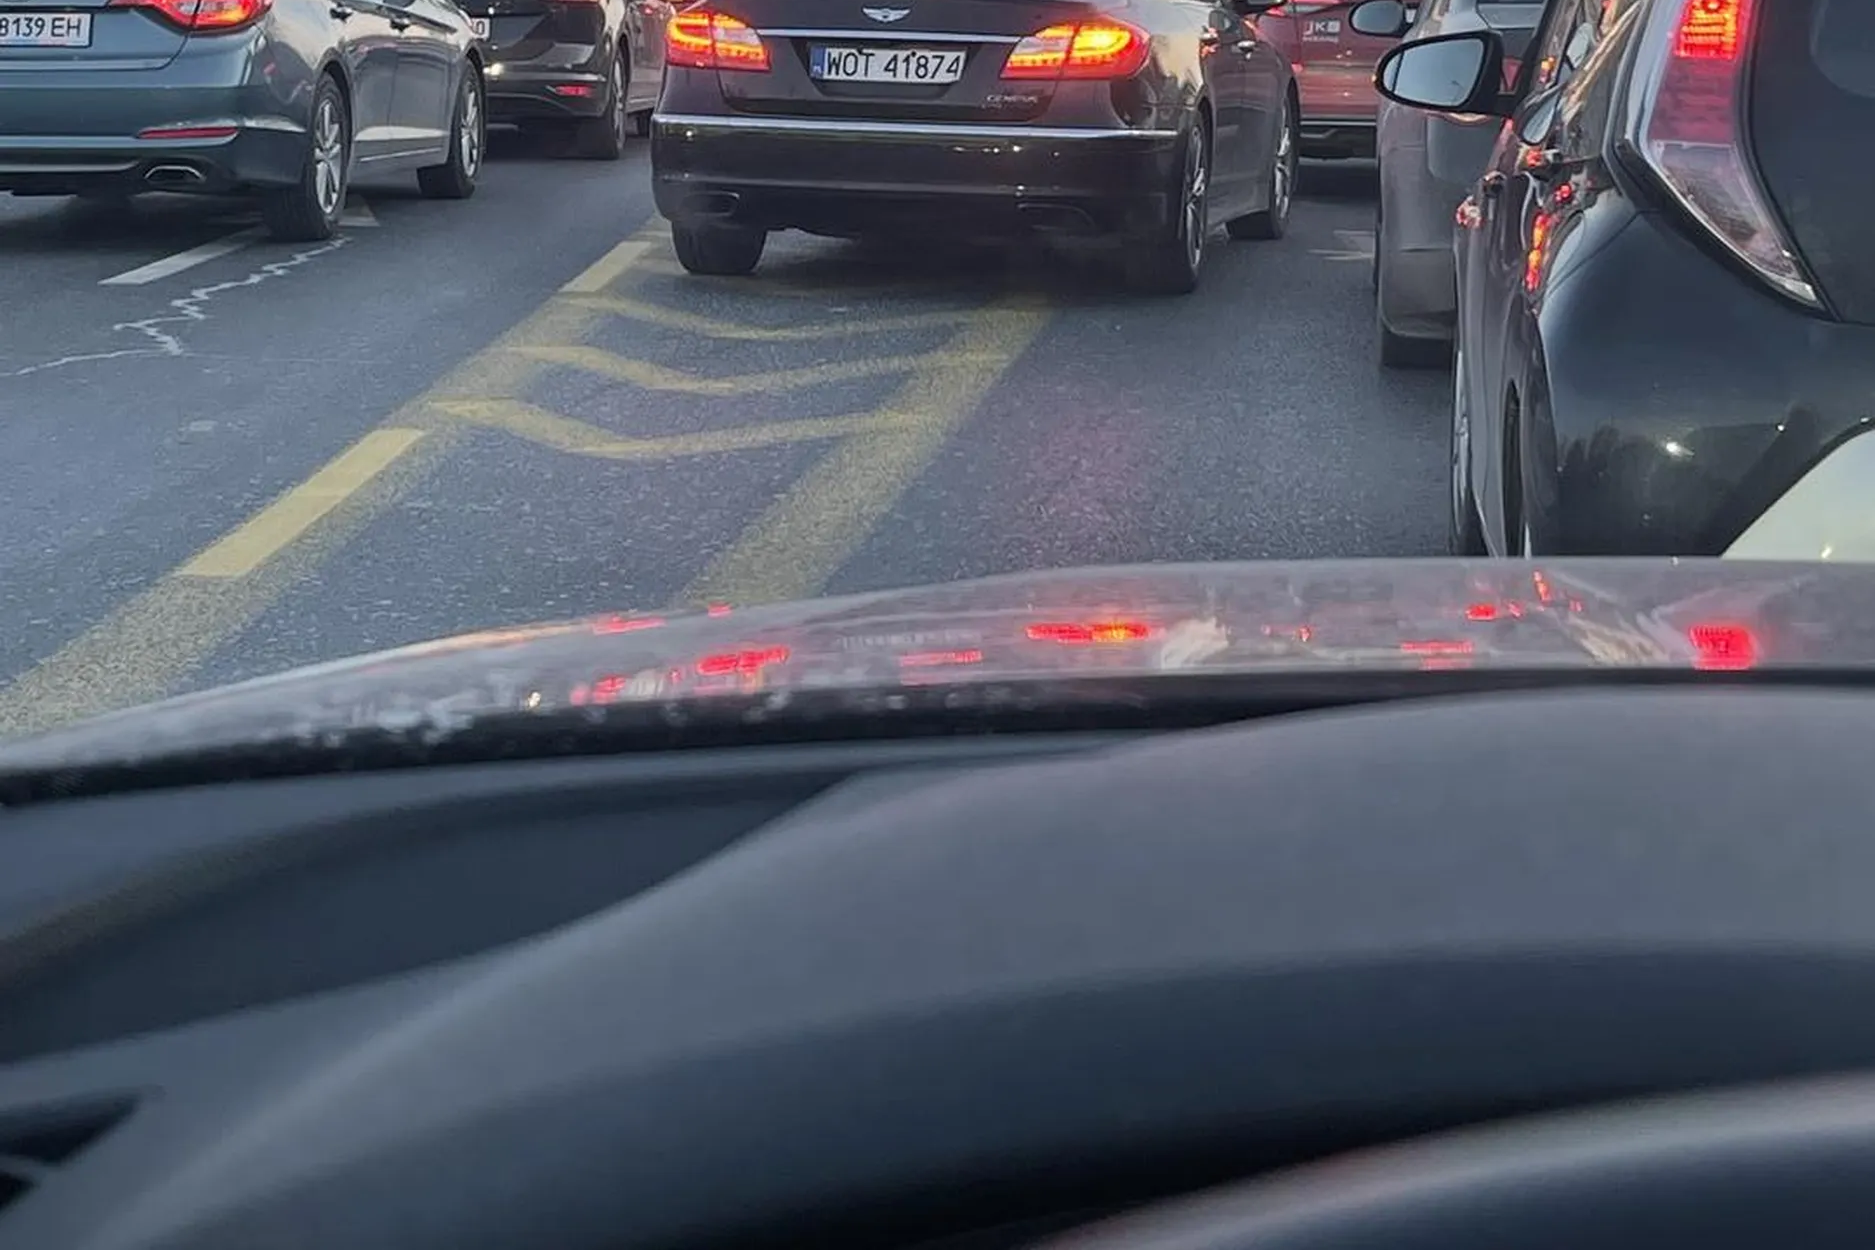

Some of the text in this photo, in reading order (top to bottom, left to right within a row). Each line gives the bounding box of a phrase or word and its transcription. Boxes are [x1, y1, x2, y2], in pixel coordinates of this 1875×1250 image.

[51, 17, 82, 37] EH
[827, 52, 961, 80] WOT 41874
